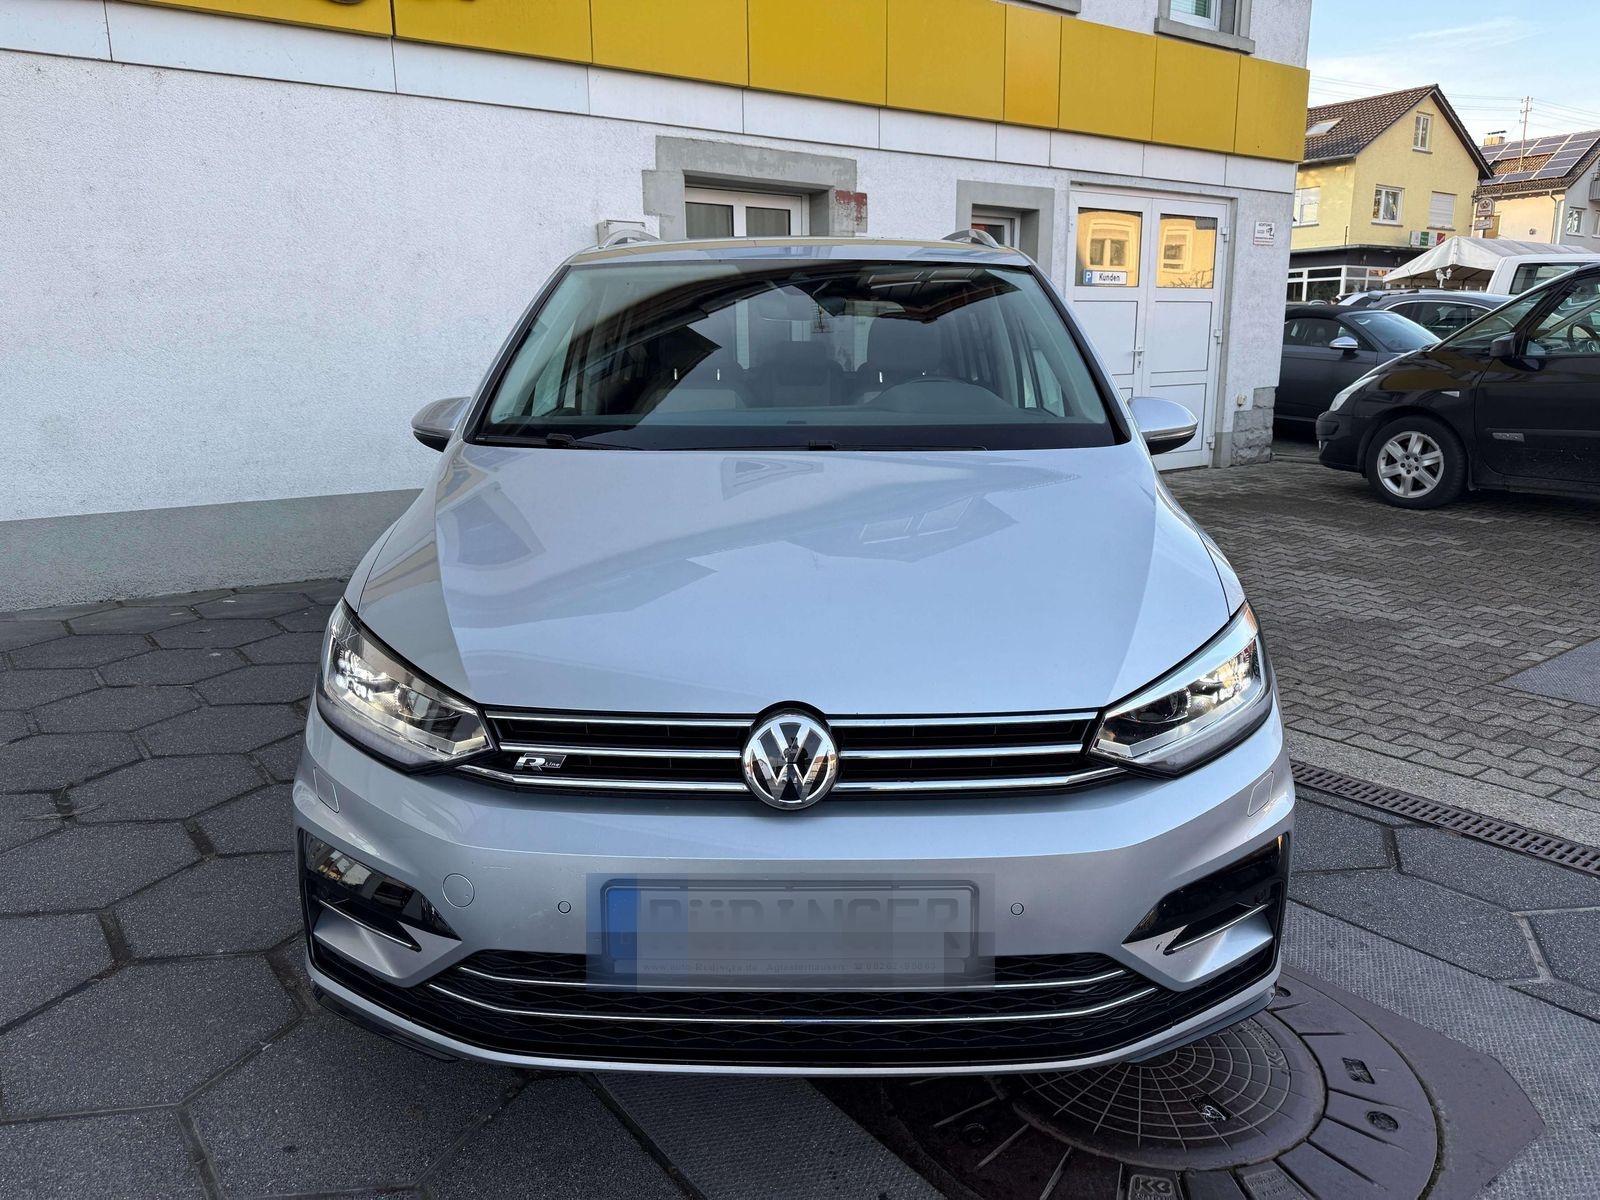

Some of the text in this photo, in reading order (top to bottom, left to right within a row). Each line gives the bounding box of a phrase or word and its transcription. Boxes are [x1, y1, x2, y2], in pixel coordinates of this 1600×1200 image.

[1085, 271, 1121, 283] P Kunden
[513, 756, 546, 771] R
[766, 963, 844, 973] Aglasterhausen
